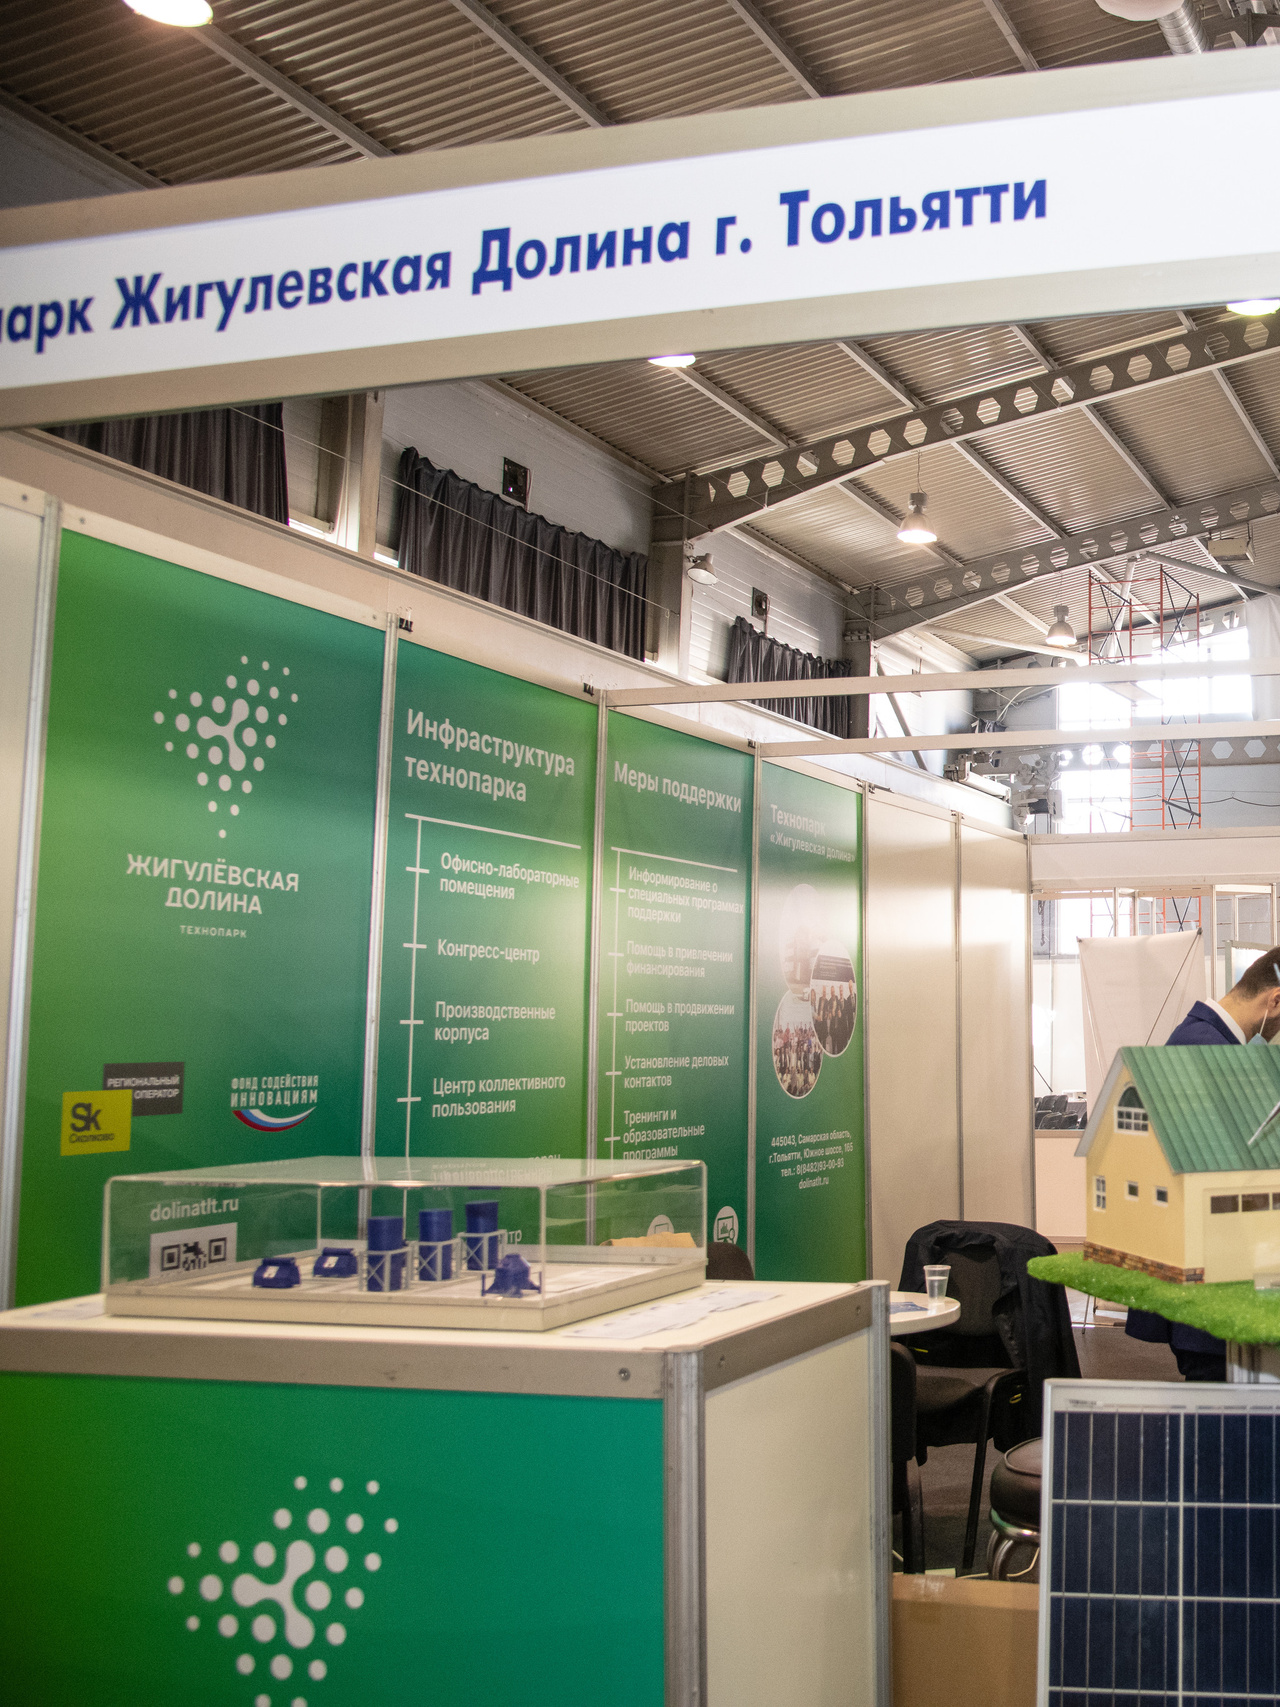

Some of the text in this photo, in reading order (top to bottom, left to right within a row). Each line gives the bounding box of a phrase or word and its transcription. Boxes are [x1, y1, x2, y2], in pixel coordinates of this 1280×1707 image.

[111, 250, 452, 332] Жигулевская
[471, 220, 690, 296] Долина
[715, 215, 752, 256] г.
[779, 179, 1048, 247] Тольятти
[406, 708, 575, 777] Инфраструктура
[405, 756, 527, 802] технопарка
[614, 761, 742, 814] Меры поддержки
[770, 803, 826, 838] Технопарк
[769, 831, 826, 857] «Жигулевская
[126, 853, 299, 892] ЖИГУЛЁВСКАЯ
[440, 852, 580, 889] Офисно-лабораторные
[628, 866, 718, 893] Информирование о
[439, 878, 515, 900] помещения
[165, 887, 263, 914] ДОЛИНА
[628, 887, 744, 914] специальных программах
[627, 906, 682, 924] поддержки
[180, 924, 247, 938] ТЕХНОПАРК
[437, 938, 541, 965] Конгресс-центр
[626, 940, 734, 963] Помощь в привлечении
[626, 961, 706, 978] финансирования
[435, 1001, 556, 1022] Производственные
[625, 999, 735, 1017] Помощь в продвижении
[434, 1027, 490, 1045] корпуса
[625, 1020, 670, 1034] проектов
[624, 1055, 729, 1070] Установление деловых
[107, 1074, 180, 1088] РЕГИОНАЛЬНЫЙ
[230, 1074, 319, 1090] ФОНД СОДЕЙСТВИЯ
[433, 1076, 566, 1097] Центр коллективного
[624, 1075, 672, 1089] контактов
[133, 1088, 180, 1100] ОПЕРАТОР
[230, 1089, 318, 1107] ИННОВАЦИЯМ
[70, 1102, 102, 1132] Sk
[432, 1099, 517, 1118] пользования
[624, 1109, 677, 1127] Тренинги и
[623, 1125, 705, 1145] образовательные
[797, 1132, 829, 1144] Самарская
[622, 1145, 678, 1160] программы
[149, 1198, 240, 1222] dolinatlt.ru
